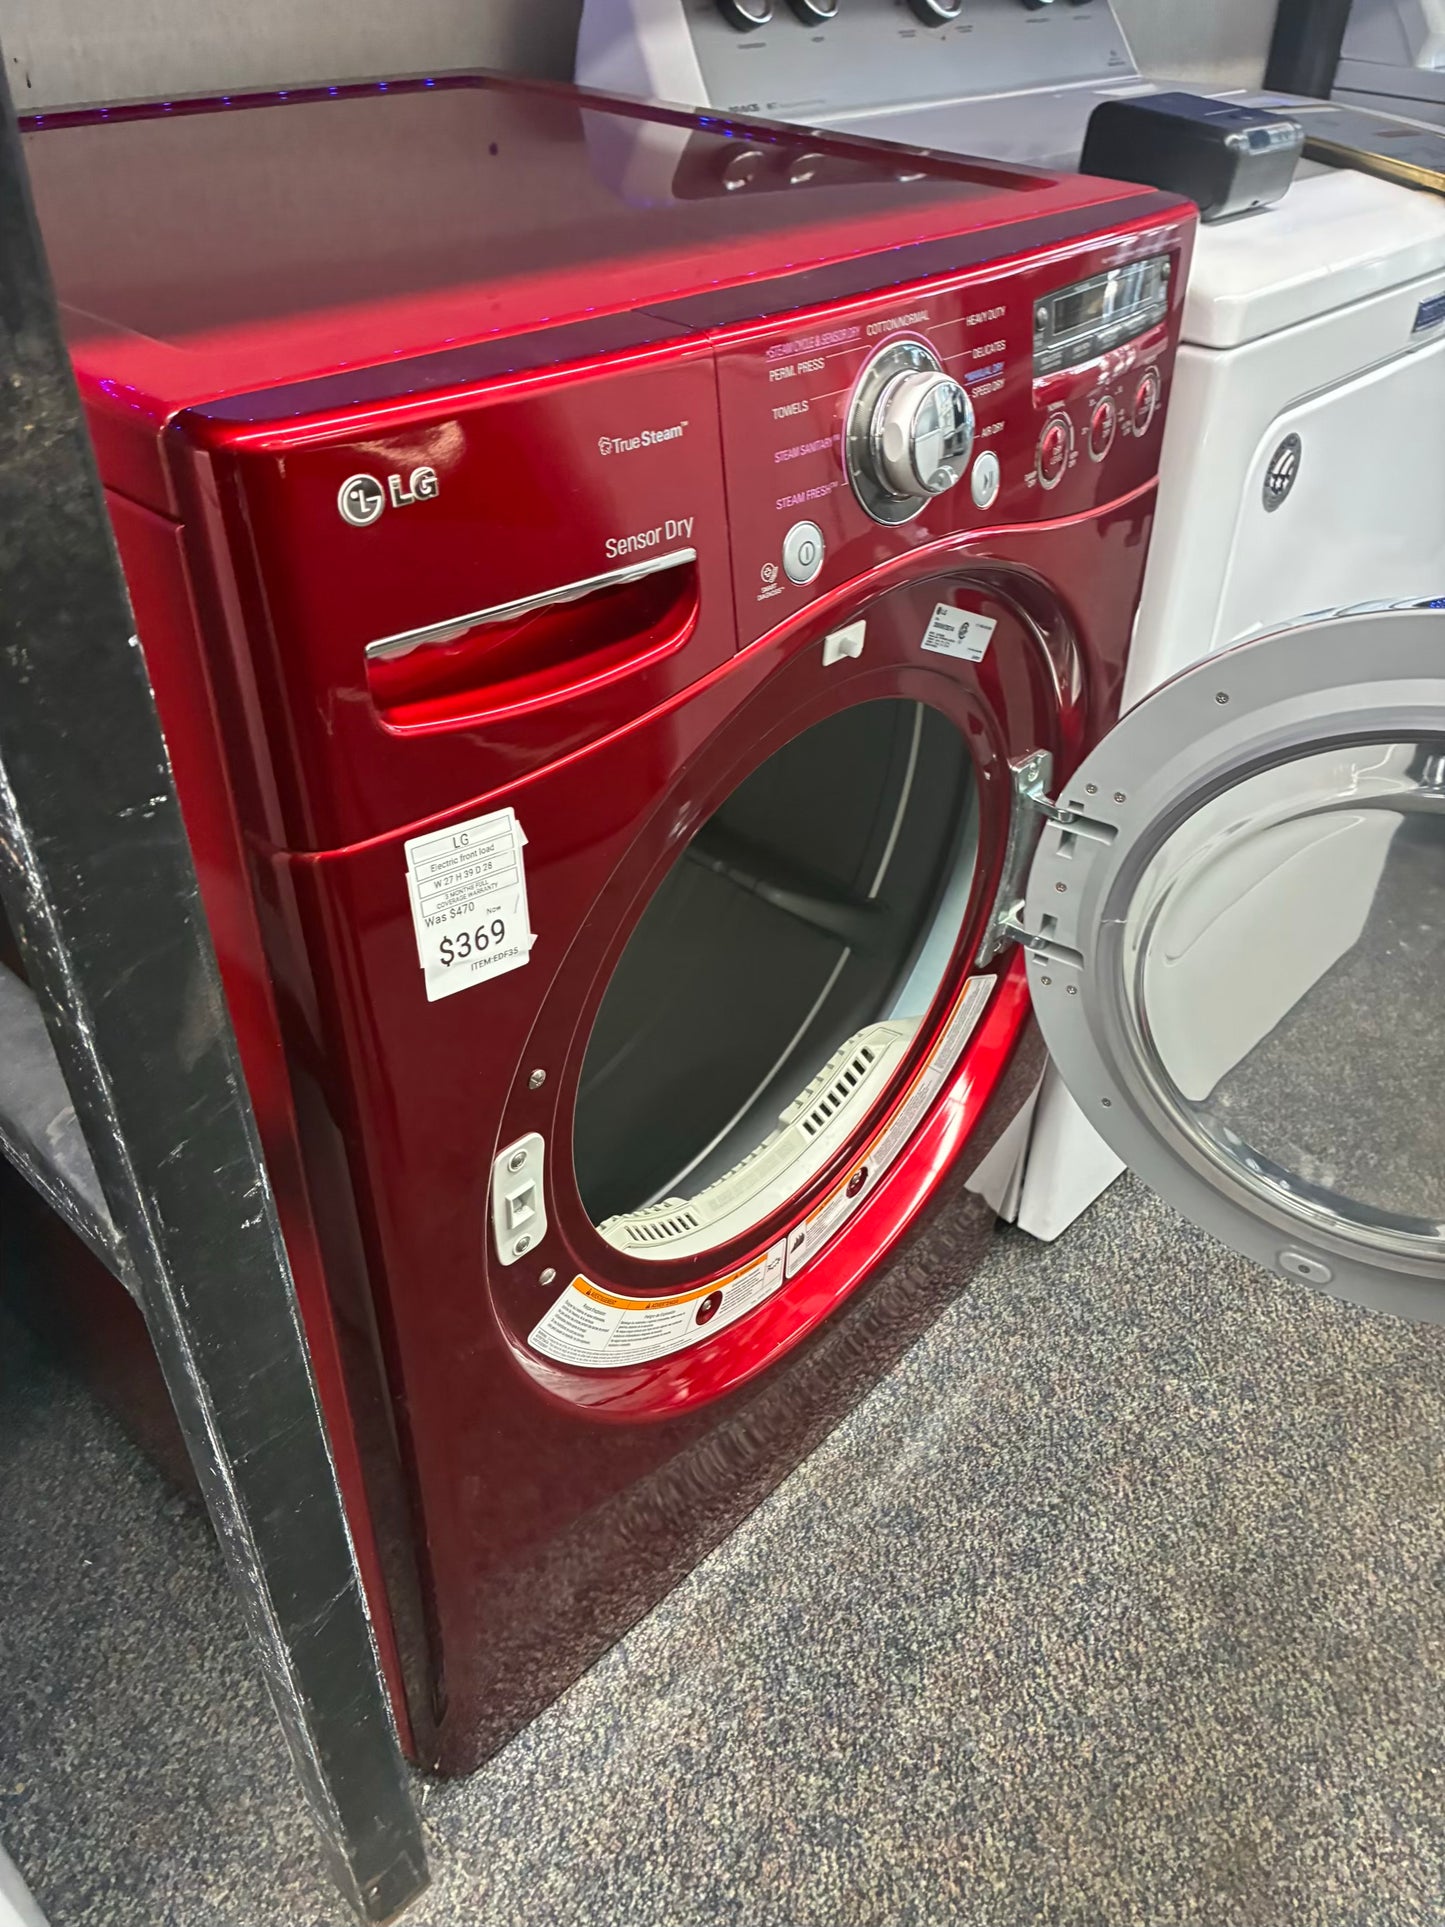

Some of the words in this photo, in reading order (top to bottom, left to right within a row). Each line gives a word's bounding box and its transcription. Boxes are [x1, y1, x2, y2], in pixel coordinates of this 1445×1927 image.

[972, 339, 1006, 359] DELICATES
[769, 365, 797, 382] PERM.
[797, 357, 825, 375] PRESS
[971, 381, 991, 398] SPEED
[771, 400, 809, 420] TOWELS
[774, 444, 799, 463] STEAM
[388, 466, 440, 508] LG
[776, 490, 806, 510] STEAM
[605, 526, 662, 559] Sensor
[665, 516, 694, 541] Dry
[453, 833, 470, 849] LG
[430, 857, 459, 873] Electric
[460, 850, 478, 863] front
[479, 843, 495, 856] load
[433, 880, 442, 889] W
[444, 875, 454, 886] 27
[456, 872, 463, 881] H
[464, 868, 474, 879] 39
[475, 865, 482, 875] D
[482, 861, 493, 872] 28
[436, 894, 467, 910] COVERAGE
[467, 882, 499, 898] WARRANTY
[450, 884, 474, 898] MONTHS
[475, 879, 489, 888] FULL
[424, 914, 447, 928] Was
[449, 901, 475, 920] $470
[486, 905, 502, 915] Now
[439, 918, 506, 967] $369
